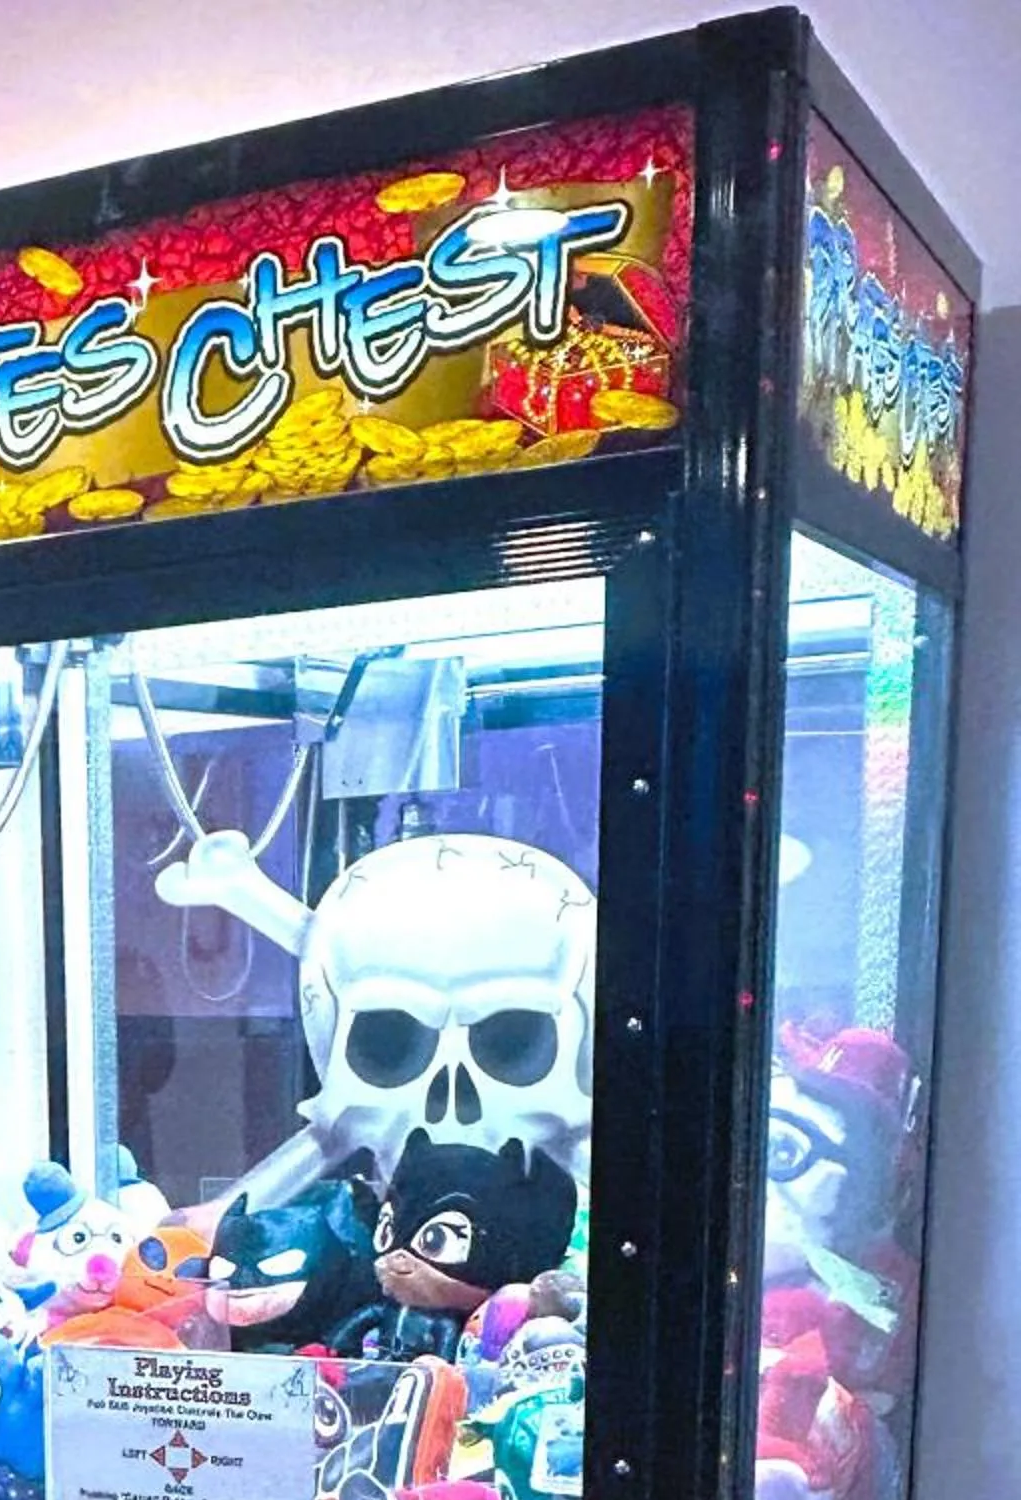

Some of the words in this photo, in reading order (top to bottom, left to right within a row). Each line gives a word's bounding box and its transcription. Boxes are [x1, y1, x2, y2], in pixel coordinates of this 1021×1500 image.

[161, 200, 627, 464] CHEST
[135, 1357, 223, 1388] Playing
[107, 1377, 252, 1406] Instructions
[122, 1448, 147, 1461] LEFT
